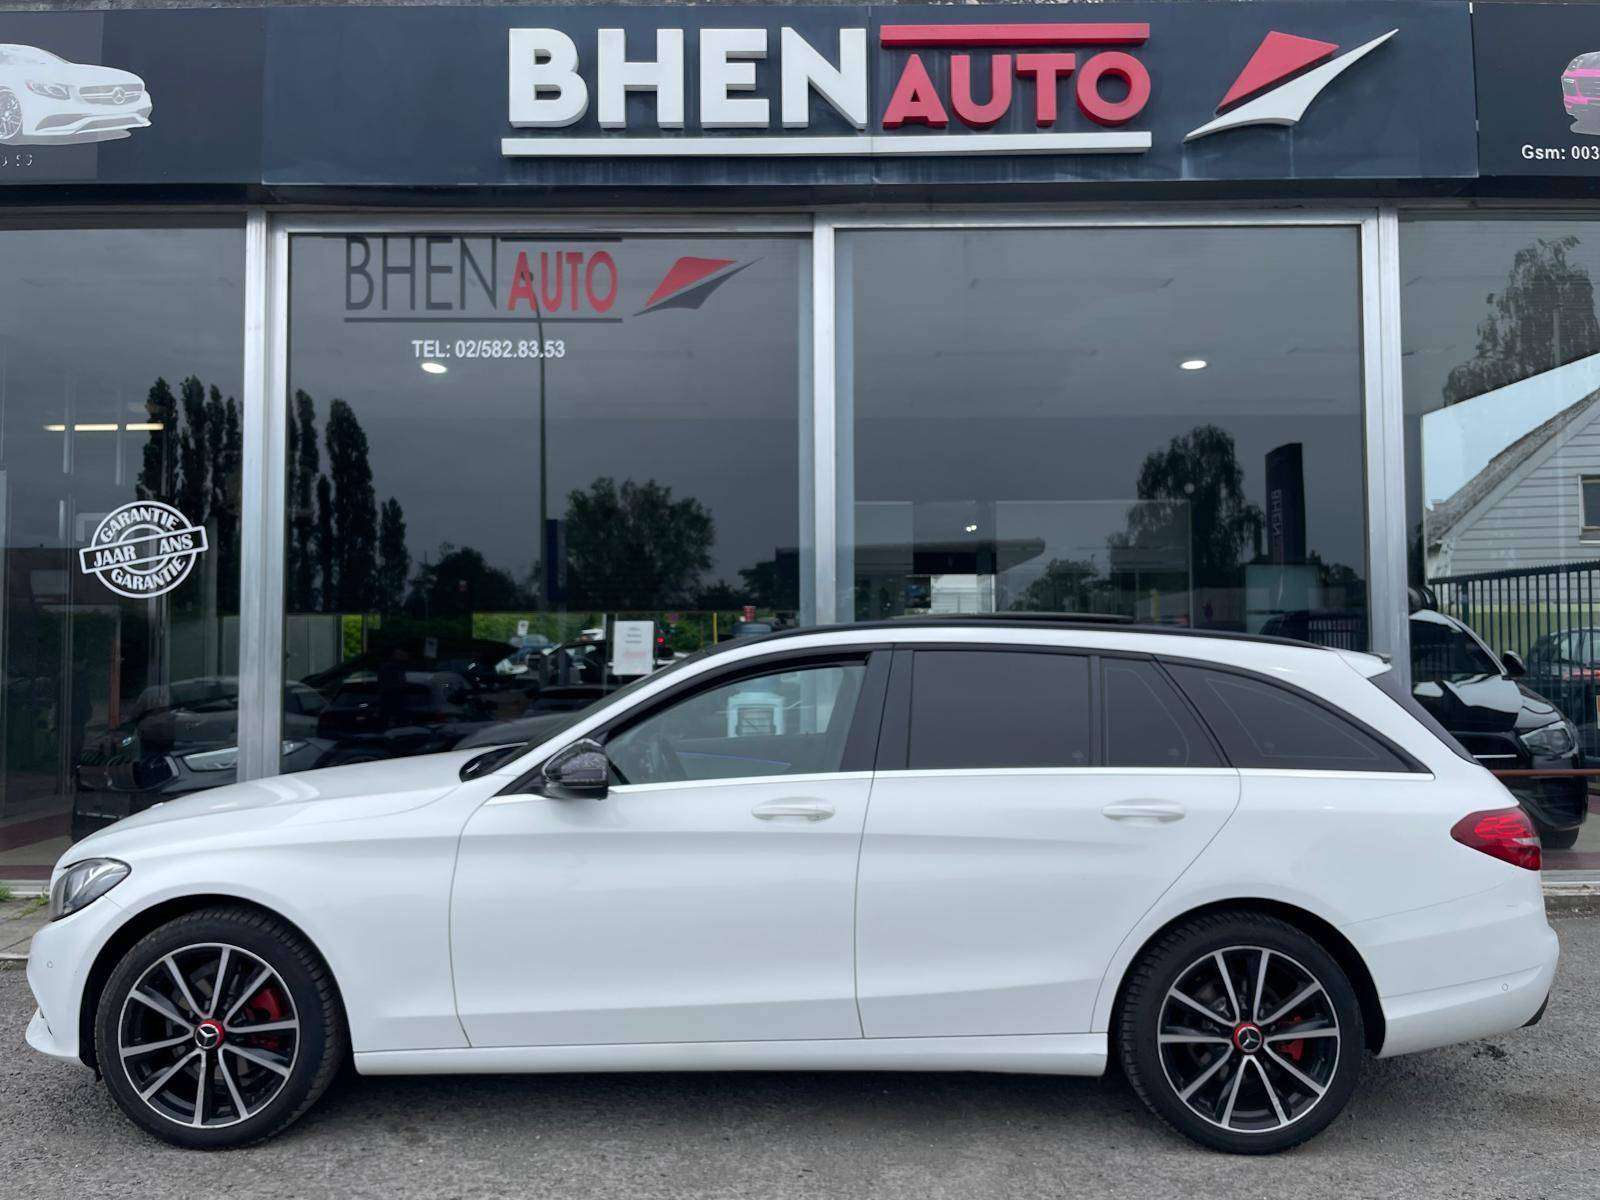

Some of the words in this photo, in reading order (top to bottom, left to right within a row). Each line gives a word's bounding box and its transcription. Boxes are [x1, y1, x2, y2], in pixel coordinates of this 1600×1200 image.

[508, 27, 868, 129] BHEN
[882, 51, 1151, 128] AUTO
[1521, 144, 1566, 160] Gsm:
[1571, 145, 1600, 160] 003
[345, 235, 498, 311] BHEN
[507, 250, 619, 314] AUTO
[411, 340, 451, 358] TEL:
[455, 339, 566, 359] 02/582.83.53
[100, 507, 180, 543] GARANTIE
[93, 545, 137, 568] JAAR
[160, 533, 194, 555] ANS
[111, 555, 186, 591] GARANTIE
